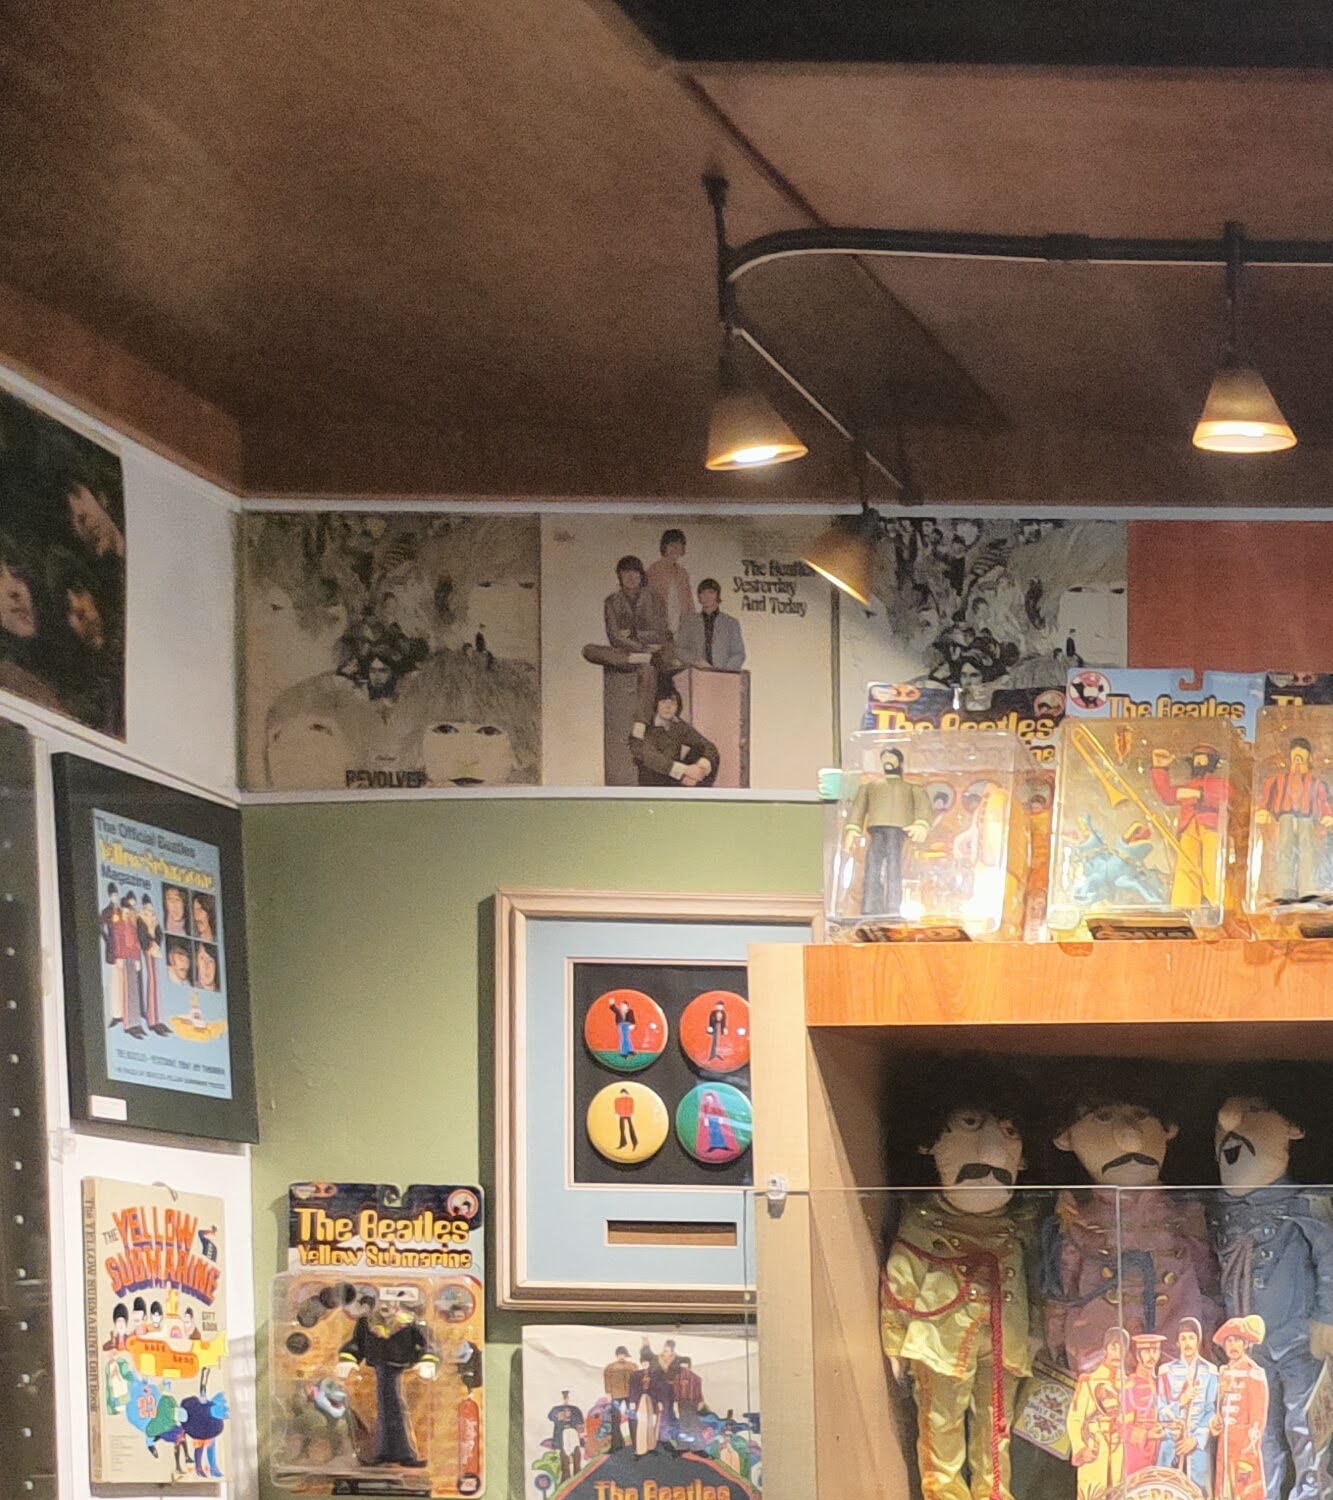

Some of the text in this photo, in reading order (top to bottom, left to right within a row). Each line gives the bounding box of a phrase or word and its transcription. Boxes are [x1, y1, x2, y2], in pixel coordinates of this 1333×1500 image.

[112, 1206, 199, 1252] YELLOW
[293, 1204, 470, 1244] The Beatles
[104, 1246, 221, 1305] SUBMARINE
[297, 1243, 473, 1269] Yellow Submarine
